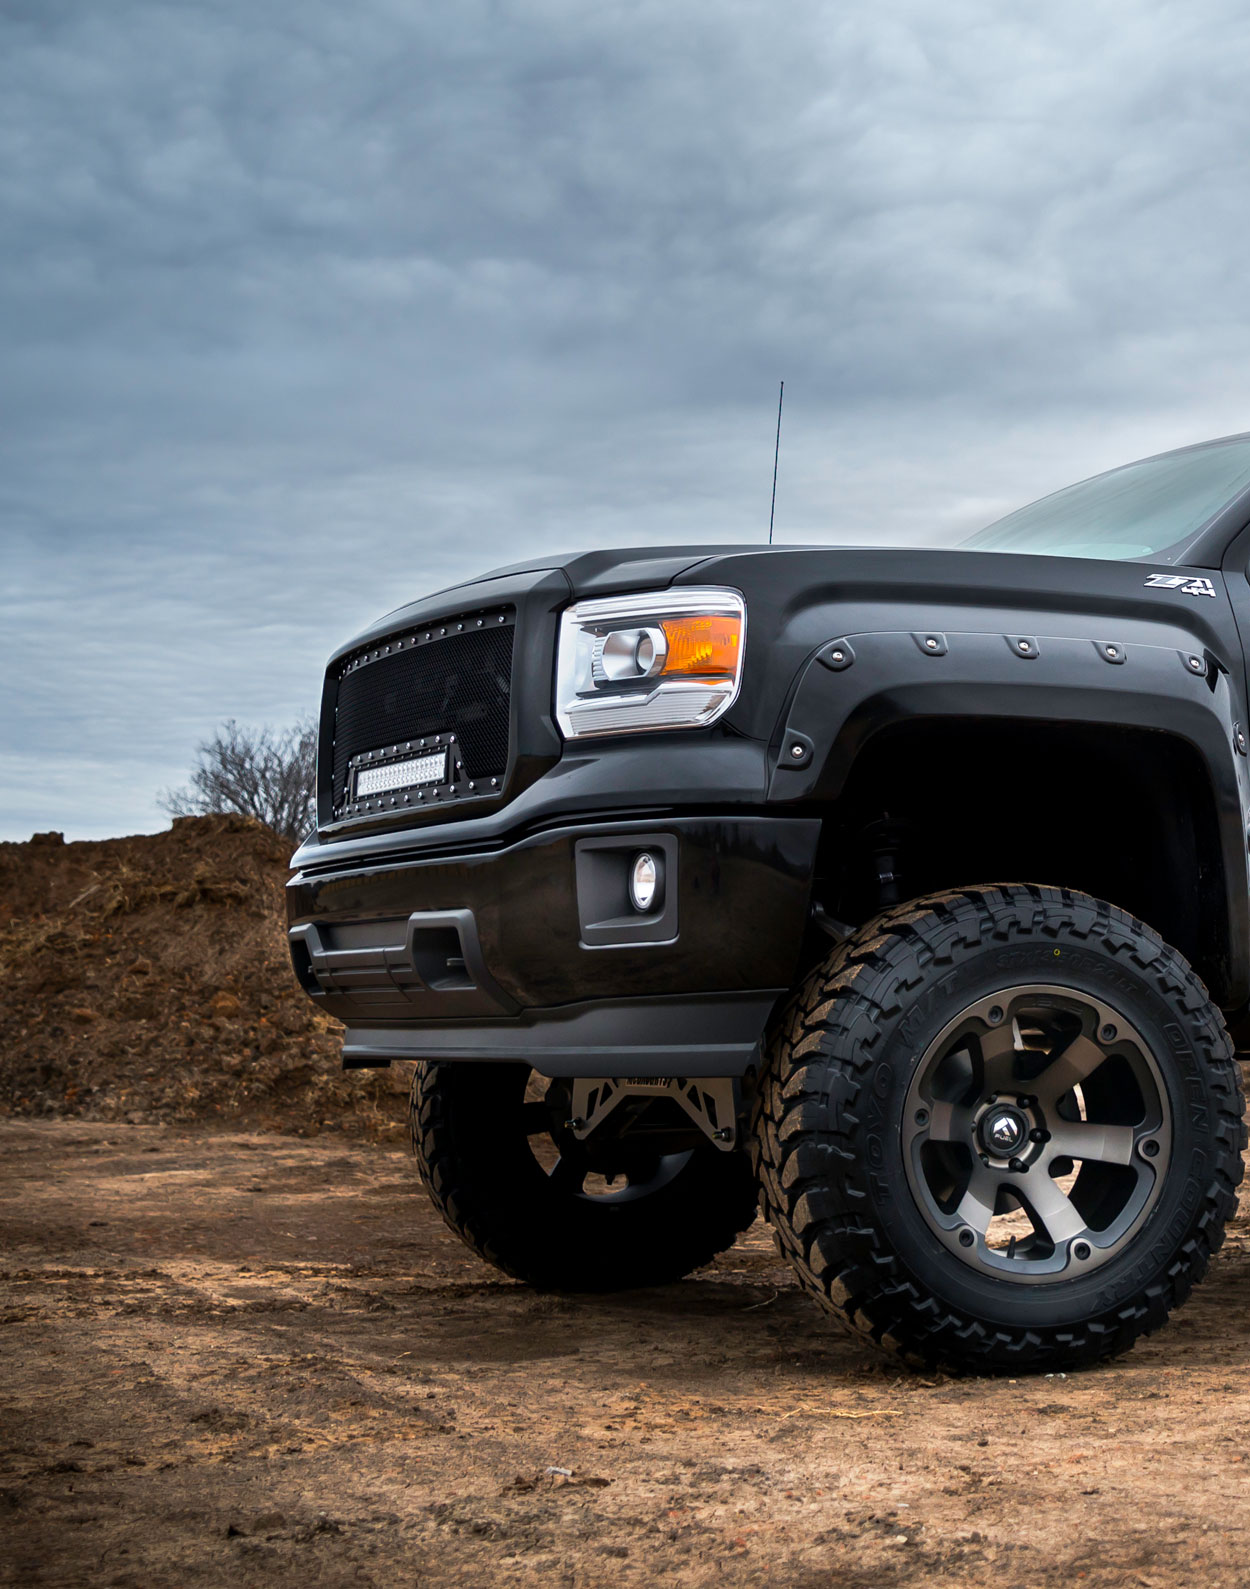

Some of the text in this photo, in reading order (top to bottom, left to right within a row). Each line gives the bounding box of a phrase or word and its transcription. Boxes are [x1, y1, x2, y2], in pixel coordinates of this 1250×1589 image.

[865, 1061, 896, 1206] TOYO
[994, 1133, 1014, 1143] FUEL
[1090, 1021, 1210, 1312] OPEN COUNTRY
